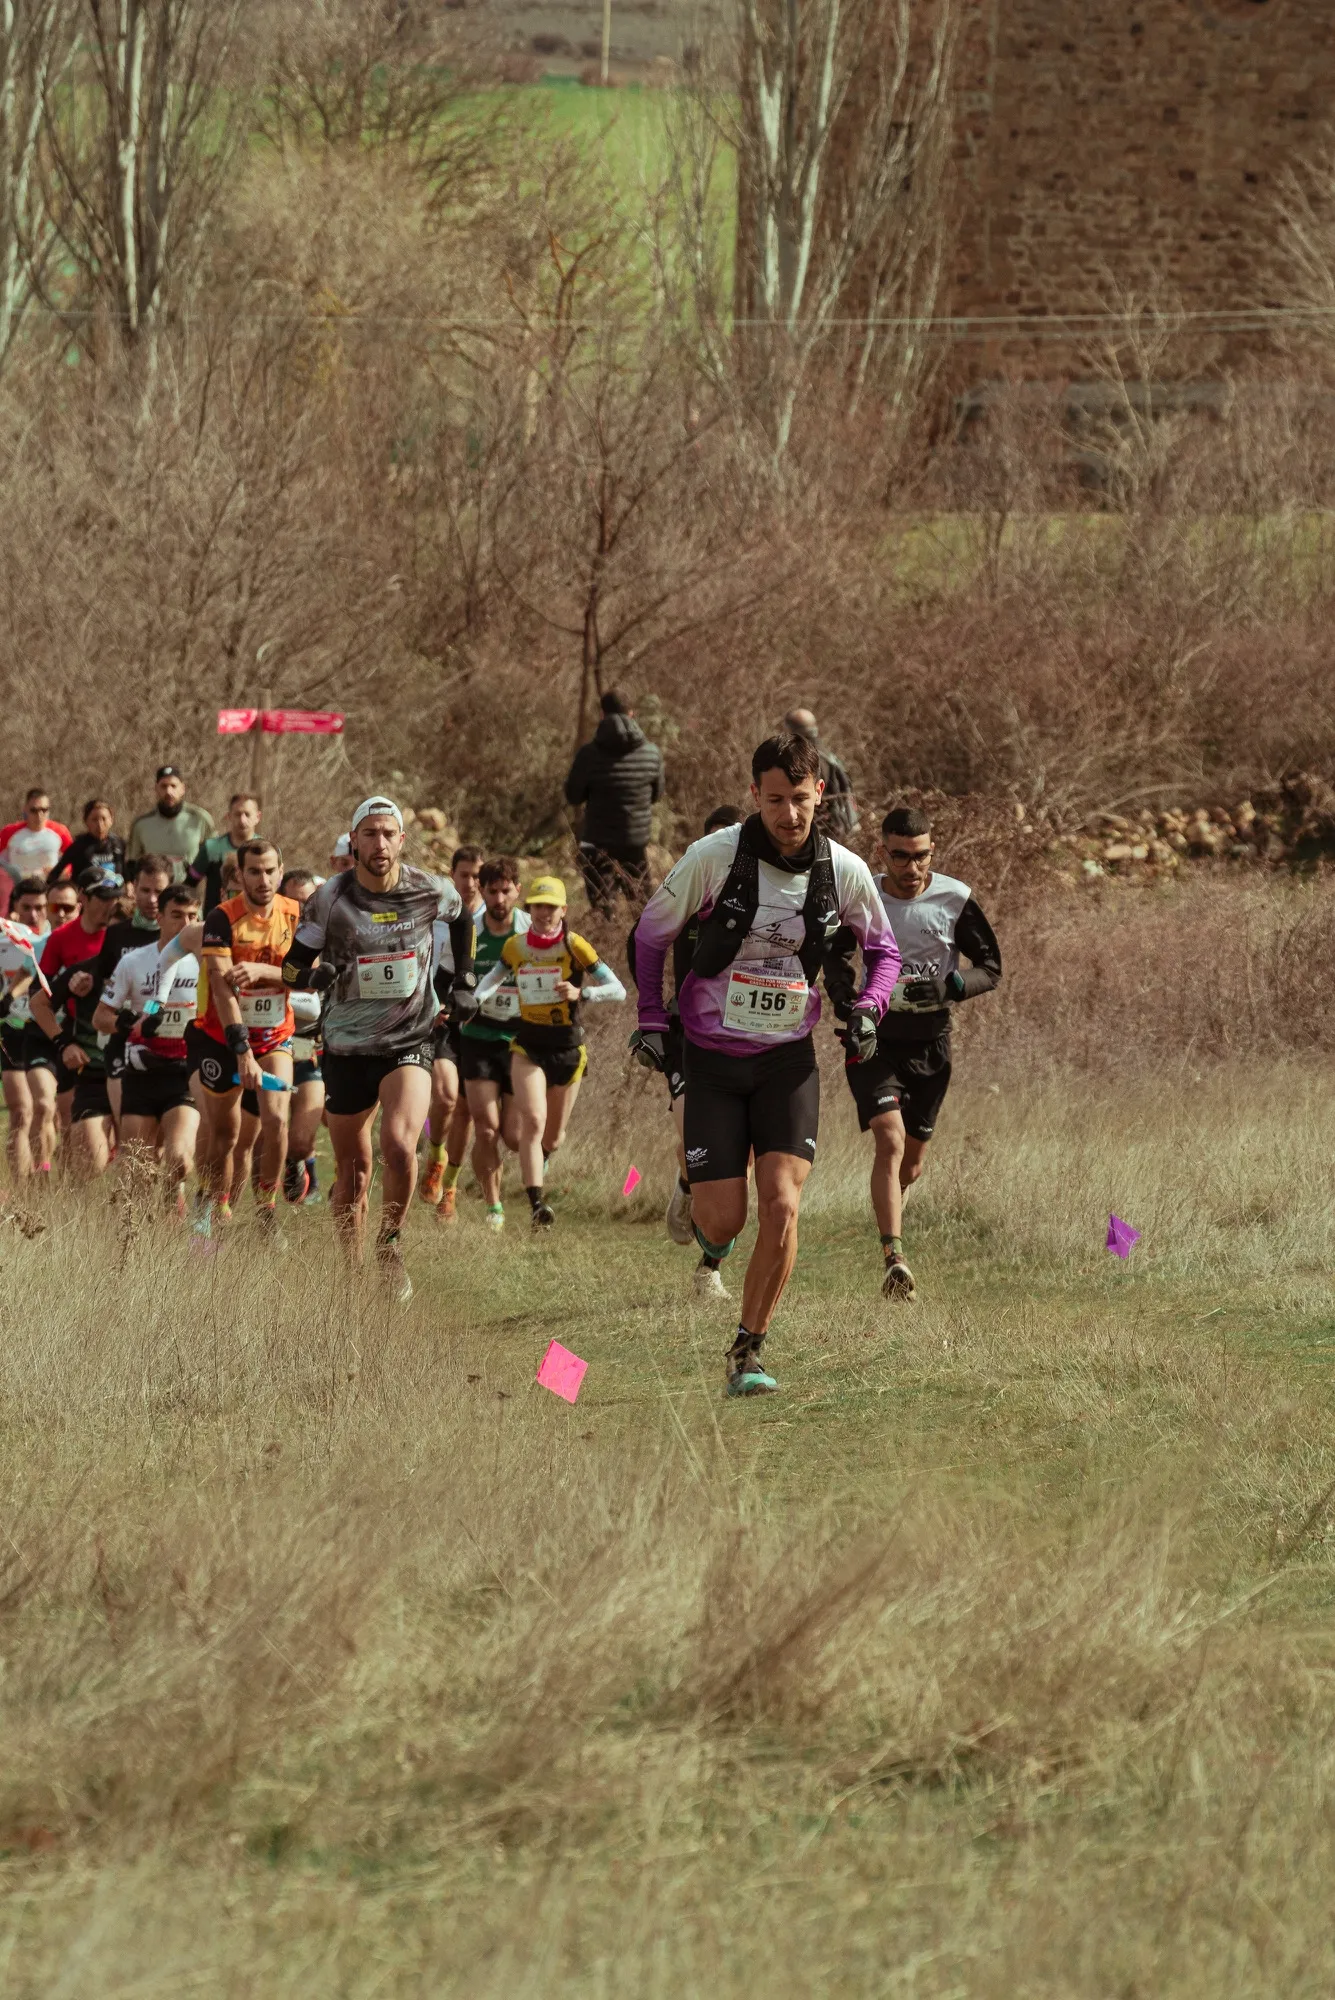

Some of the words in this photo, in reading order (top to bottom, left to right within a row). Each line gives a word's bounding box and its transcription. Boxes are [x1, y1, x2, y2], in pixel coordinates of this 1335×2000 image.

[384, 965, 394, 980] 6
[536, 976, 542, 988] 1
[254, 998, 271, 1011] 60
[495, 995, 511, 1007] 64
[748, 990, 787, 1011] 156
[164, 1010, 181, 1022] 70
